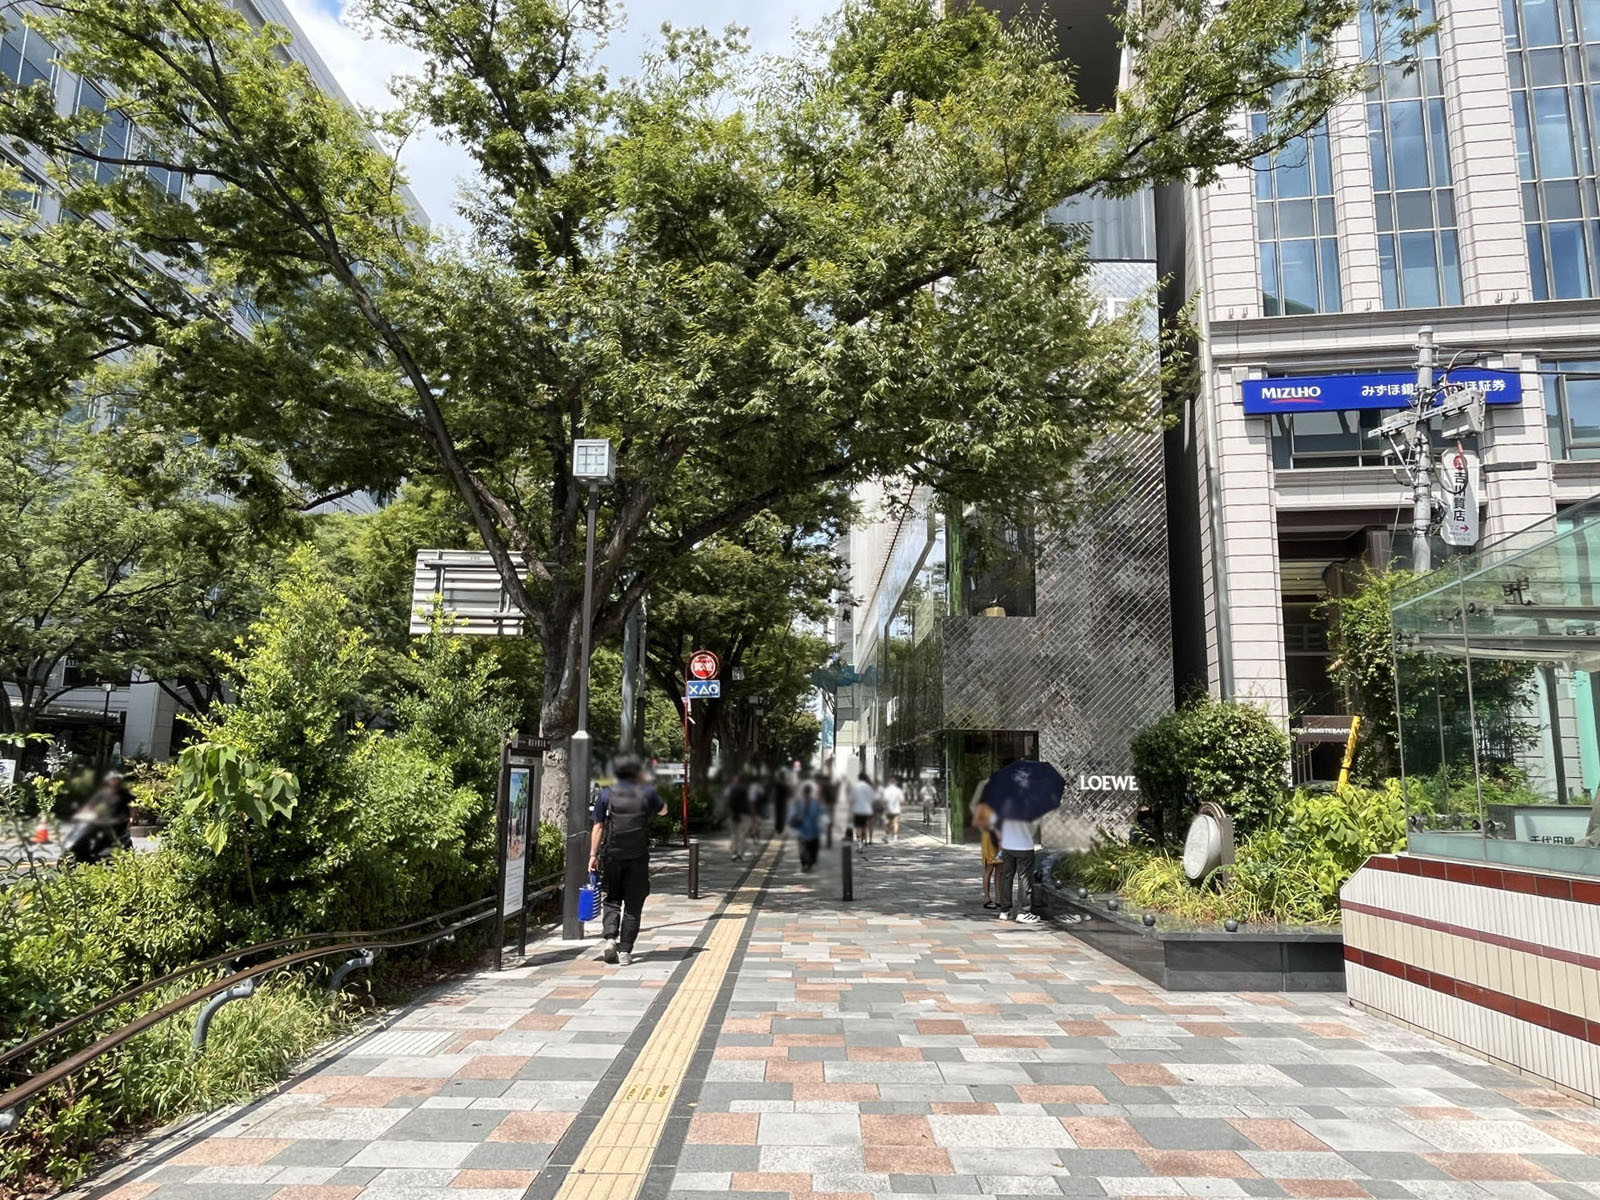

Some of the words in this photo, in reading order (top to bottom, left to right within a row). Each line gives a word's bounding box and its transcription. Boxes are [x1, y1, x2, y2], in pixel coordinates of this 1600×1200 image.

[1261, 386, 1321, 399] MIZUHO
[1361, 383, 1429, 396] みずほ銀
[1453, 472, 1467, 522] 吉川質店
[1079, 774, 1139, 791] LOEWE
